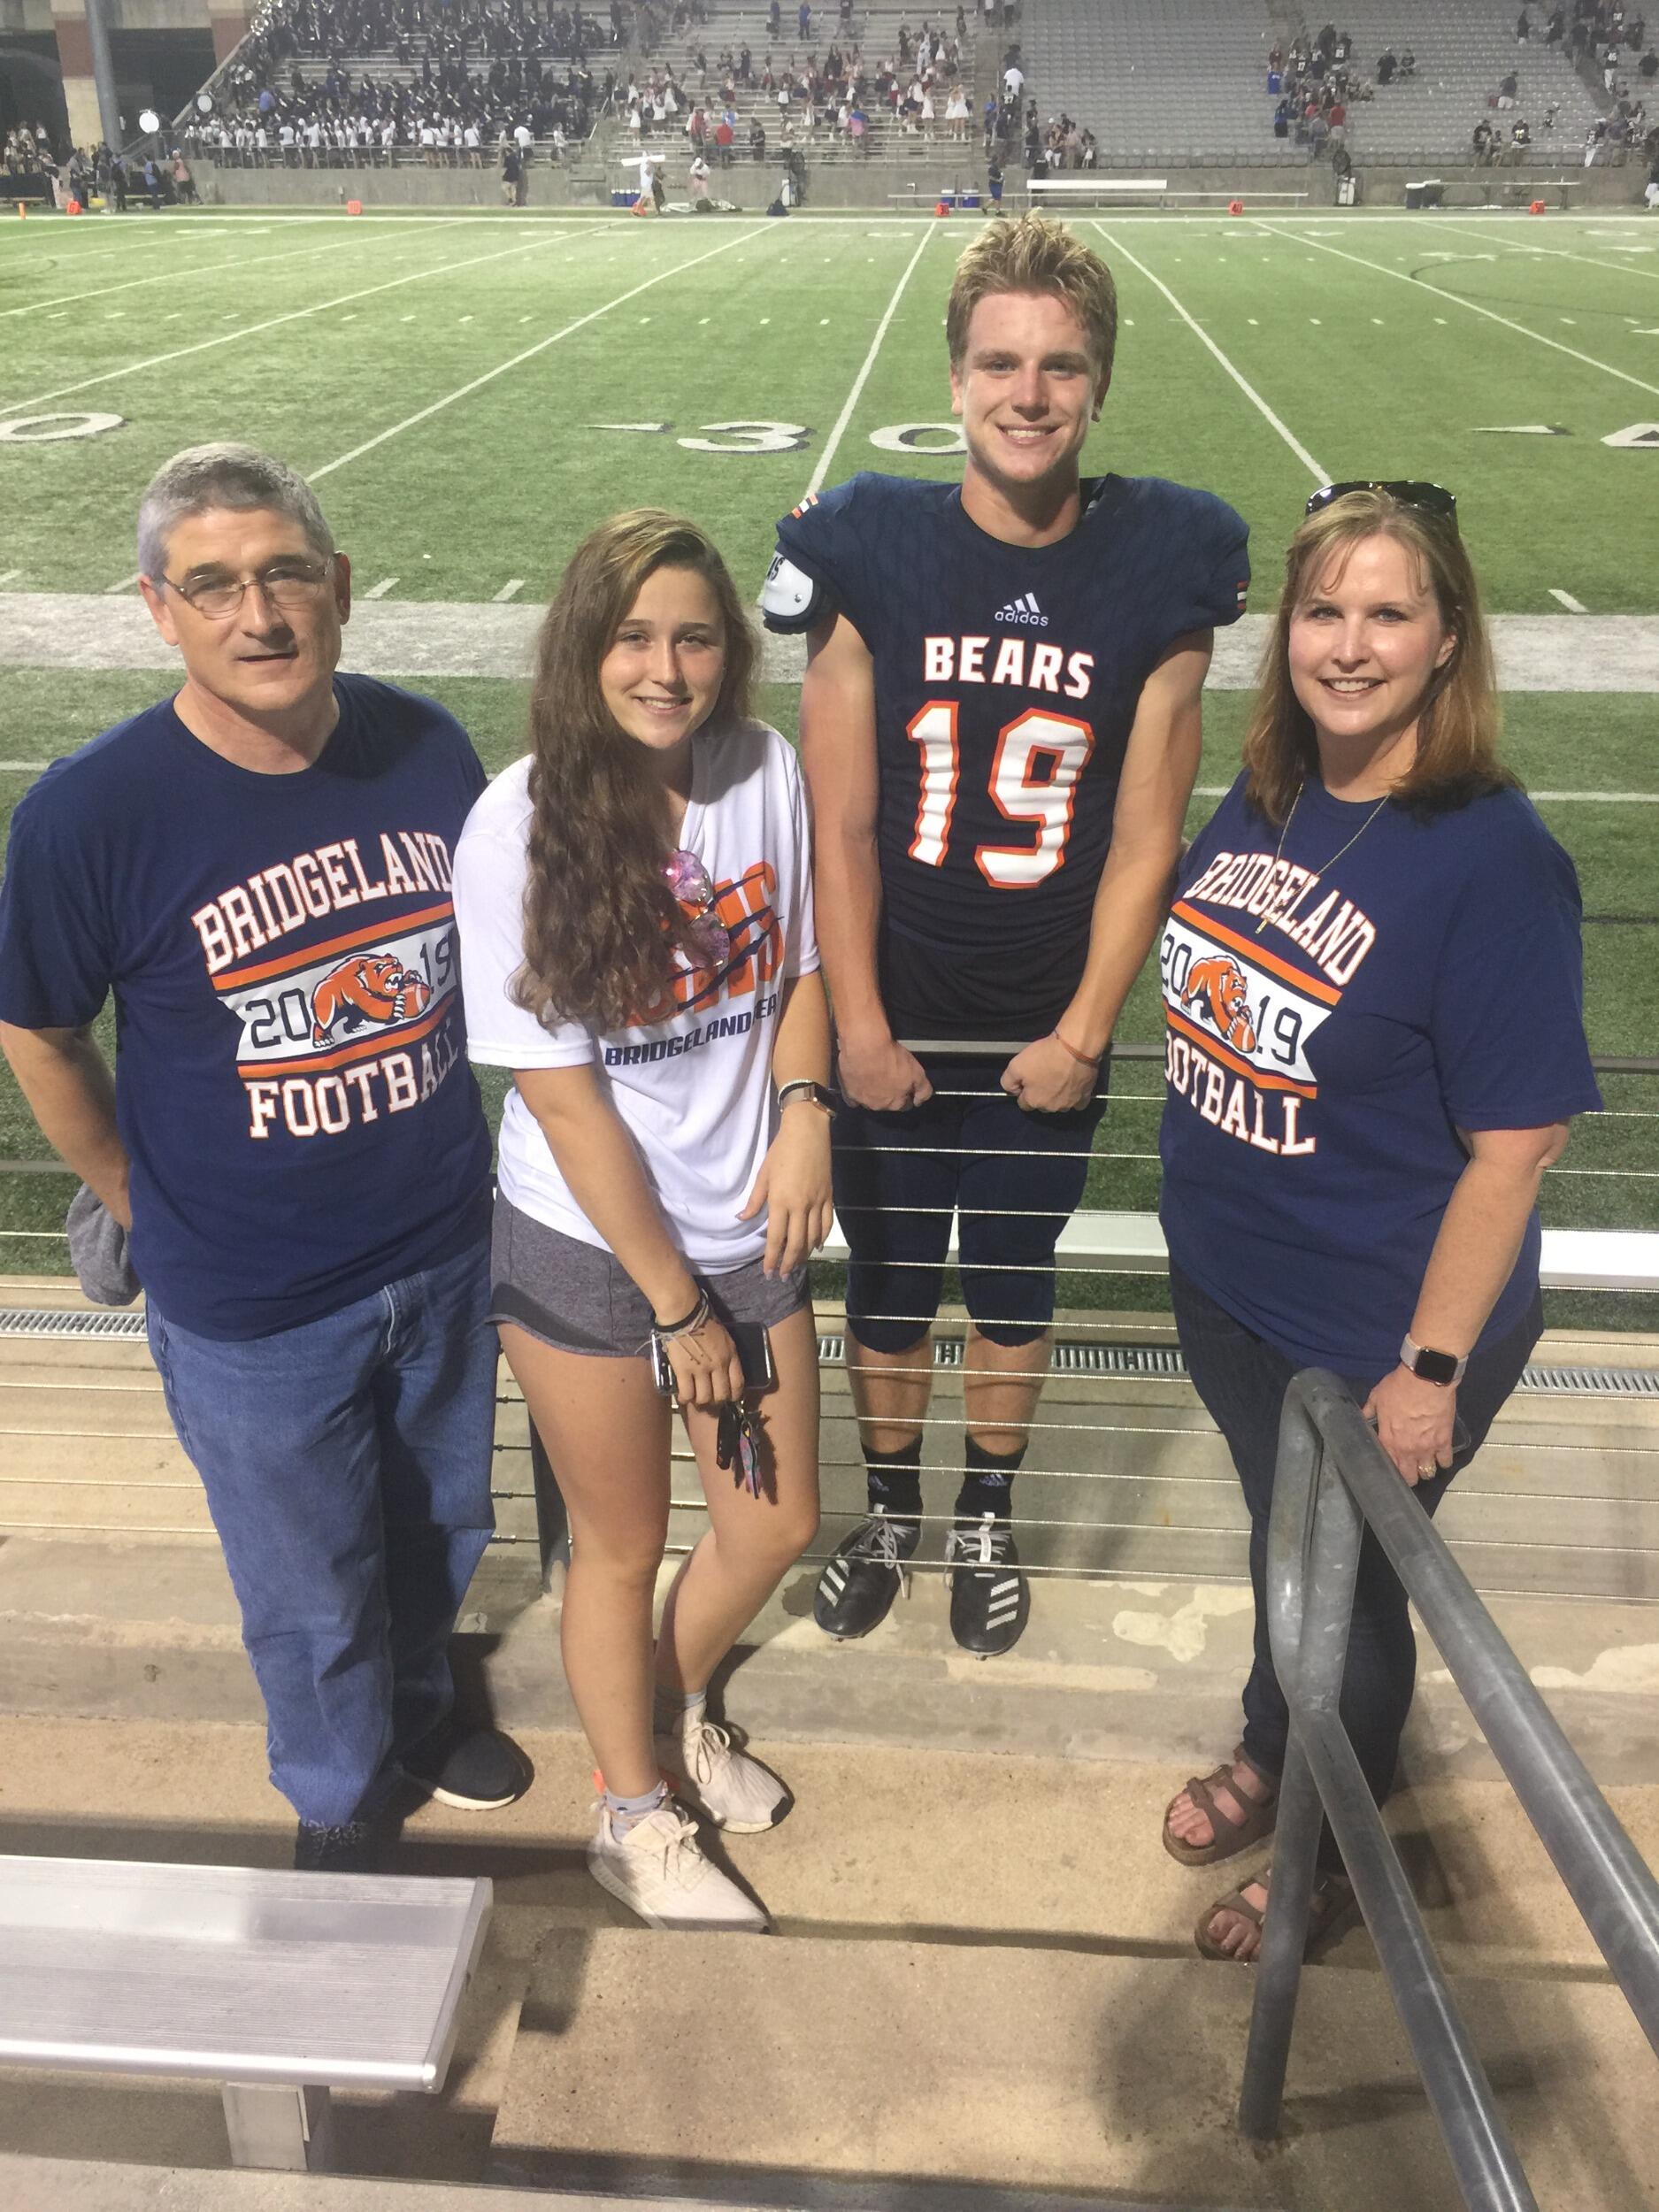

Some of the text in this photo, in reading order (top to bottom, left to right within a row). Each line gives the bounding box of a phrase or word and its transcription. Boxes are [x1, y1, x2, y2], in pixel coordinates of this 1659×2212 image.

[924, 634, 1095, 700] BEARS
[995, 610, 1049, 627] adidas
[905, 699, 1096, 890] 19
[190, 830, 453, 977] BRIDGELAND
[1182, 850, 1377, 987] BRIDGELAND
[245, 926, 457, 1049] 20 19
[604, 1010, 752, 1066] BRIDGELAND
[1256, 995, 1302, 1066] 19
[244, 1016, 459, 1140] FOOTBALL
